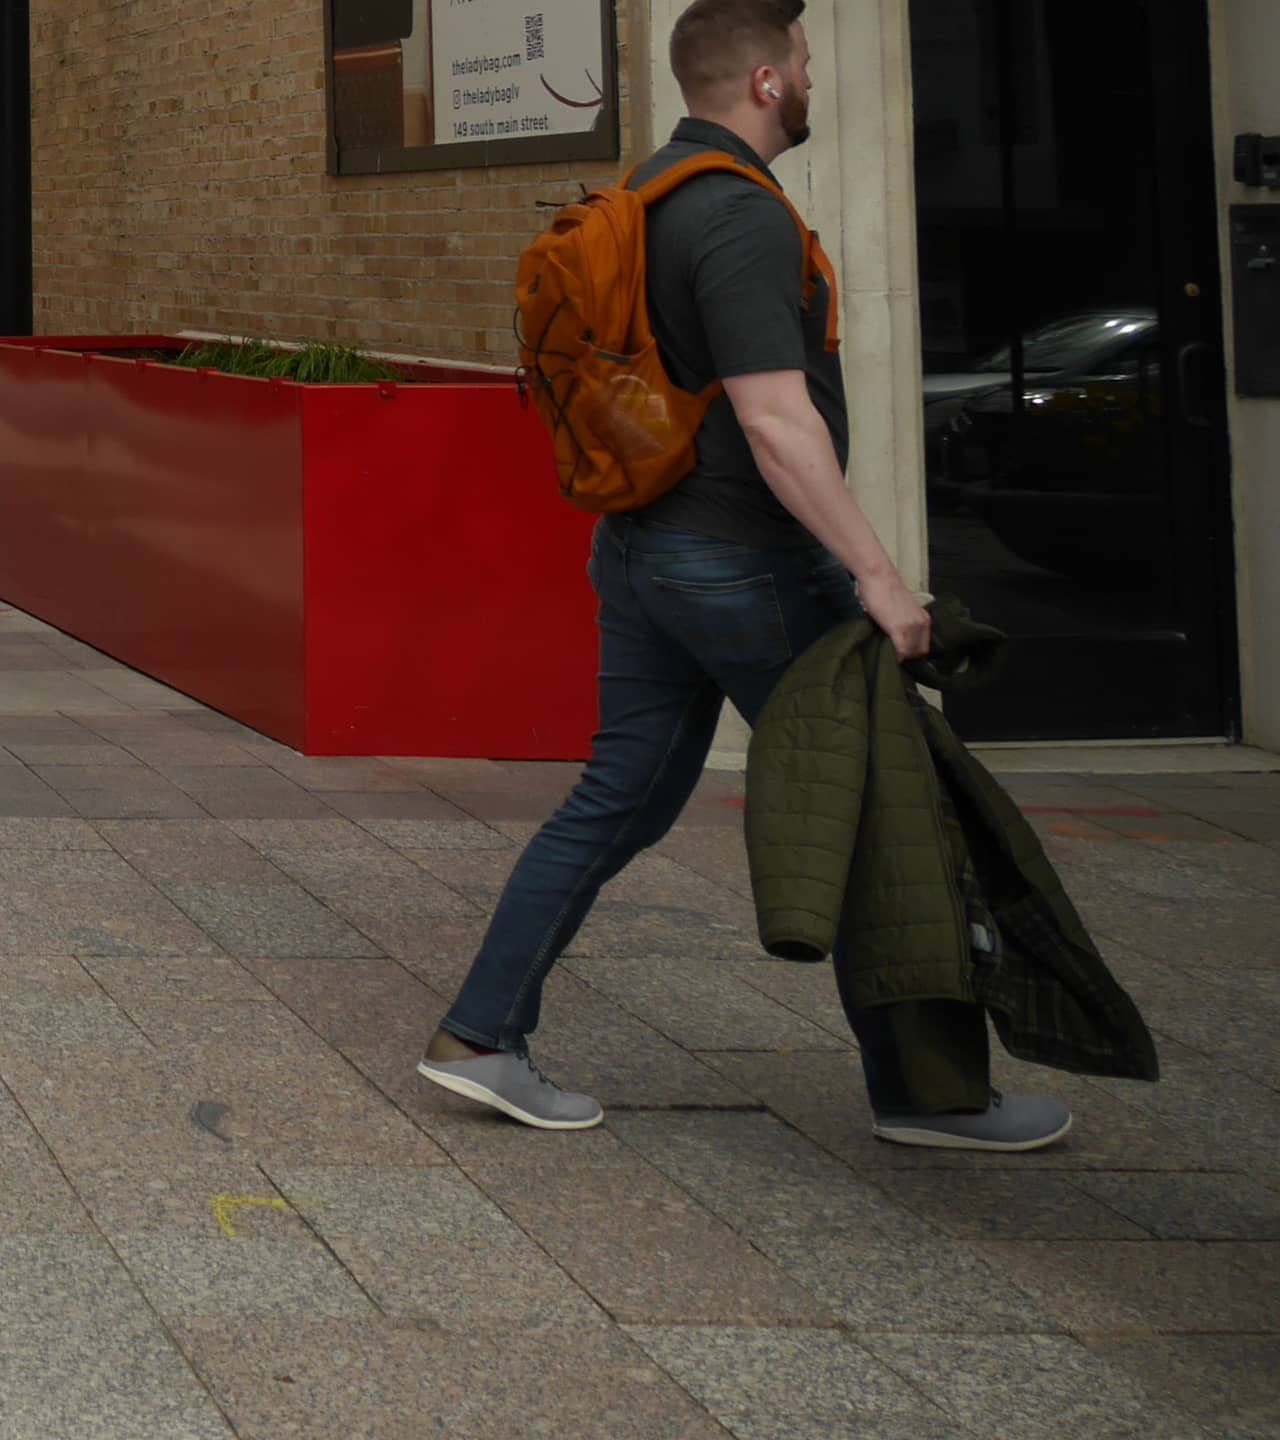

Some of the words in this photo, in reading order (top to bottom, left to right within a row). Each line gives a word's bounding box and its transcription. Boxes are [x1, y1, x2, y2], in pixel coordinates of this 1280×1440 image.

[452, 53, 521, 76] theladybag.com
[453, 121, 468, 138] 149
[470, 118, 494, 136] south
[496, 116, 519, 134] main
[521, 114, 549, 131] street
